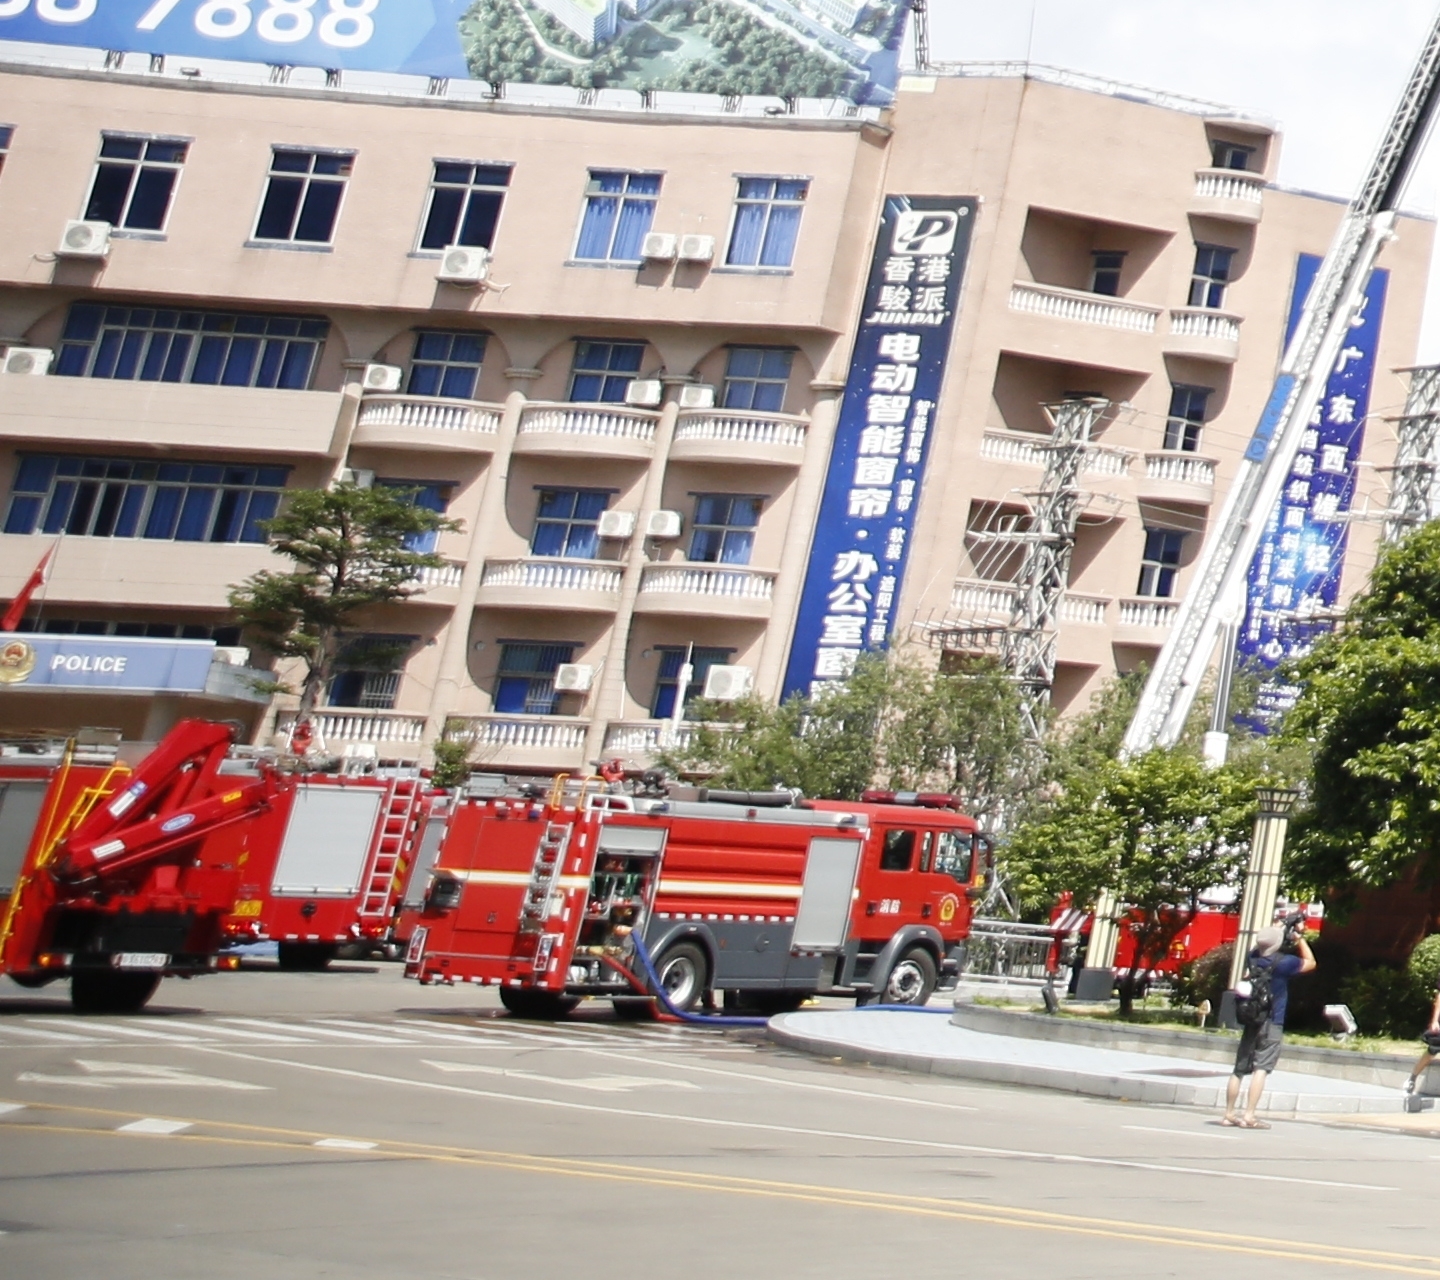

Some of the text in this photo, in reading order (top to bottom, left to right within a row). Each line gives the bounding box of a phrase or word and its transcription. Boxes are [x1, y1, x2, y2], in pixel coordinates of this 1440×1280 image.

[885, 255, 950, 282] 香港
[865, 312, 945, 325] JUNPAI
[51, 654, 128, 672] POLICE
